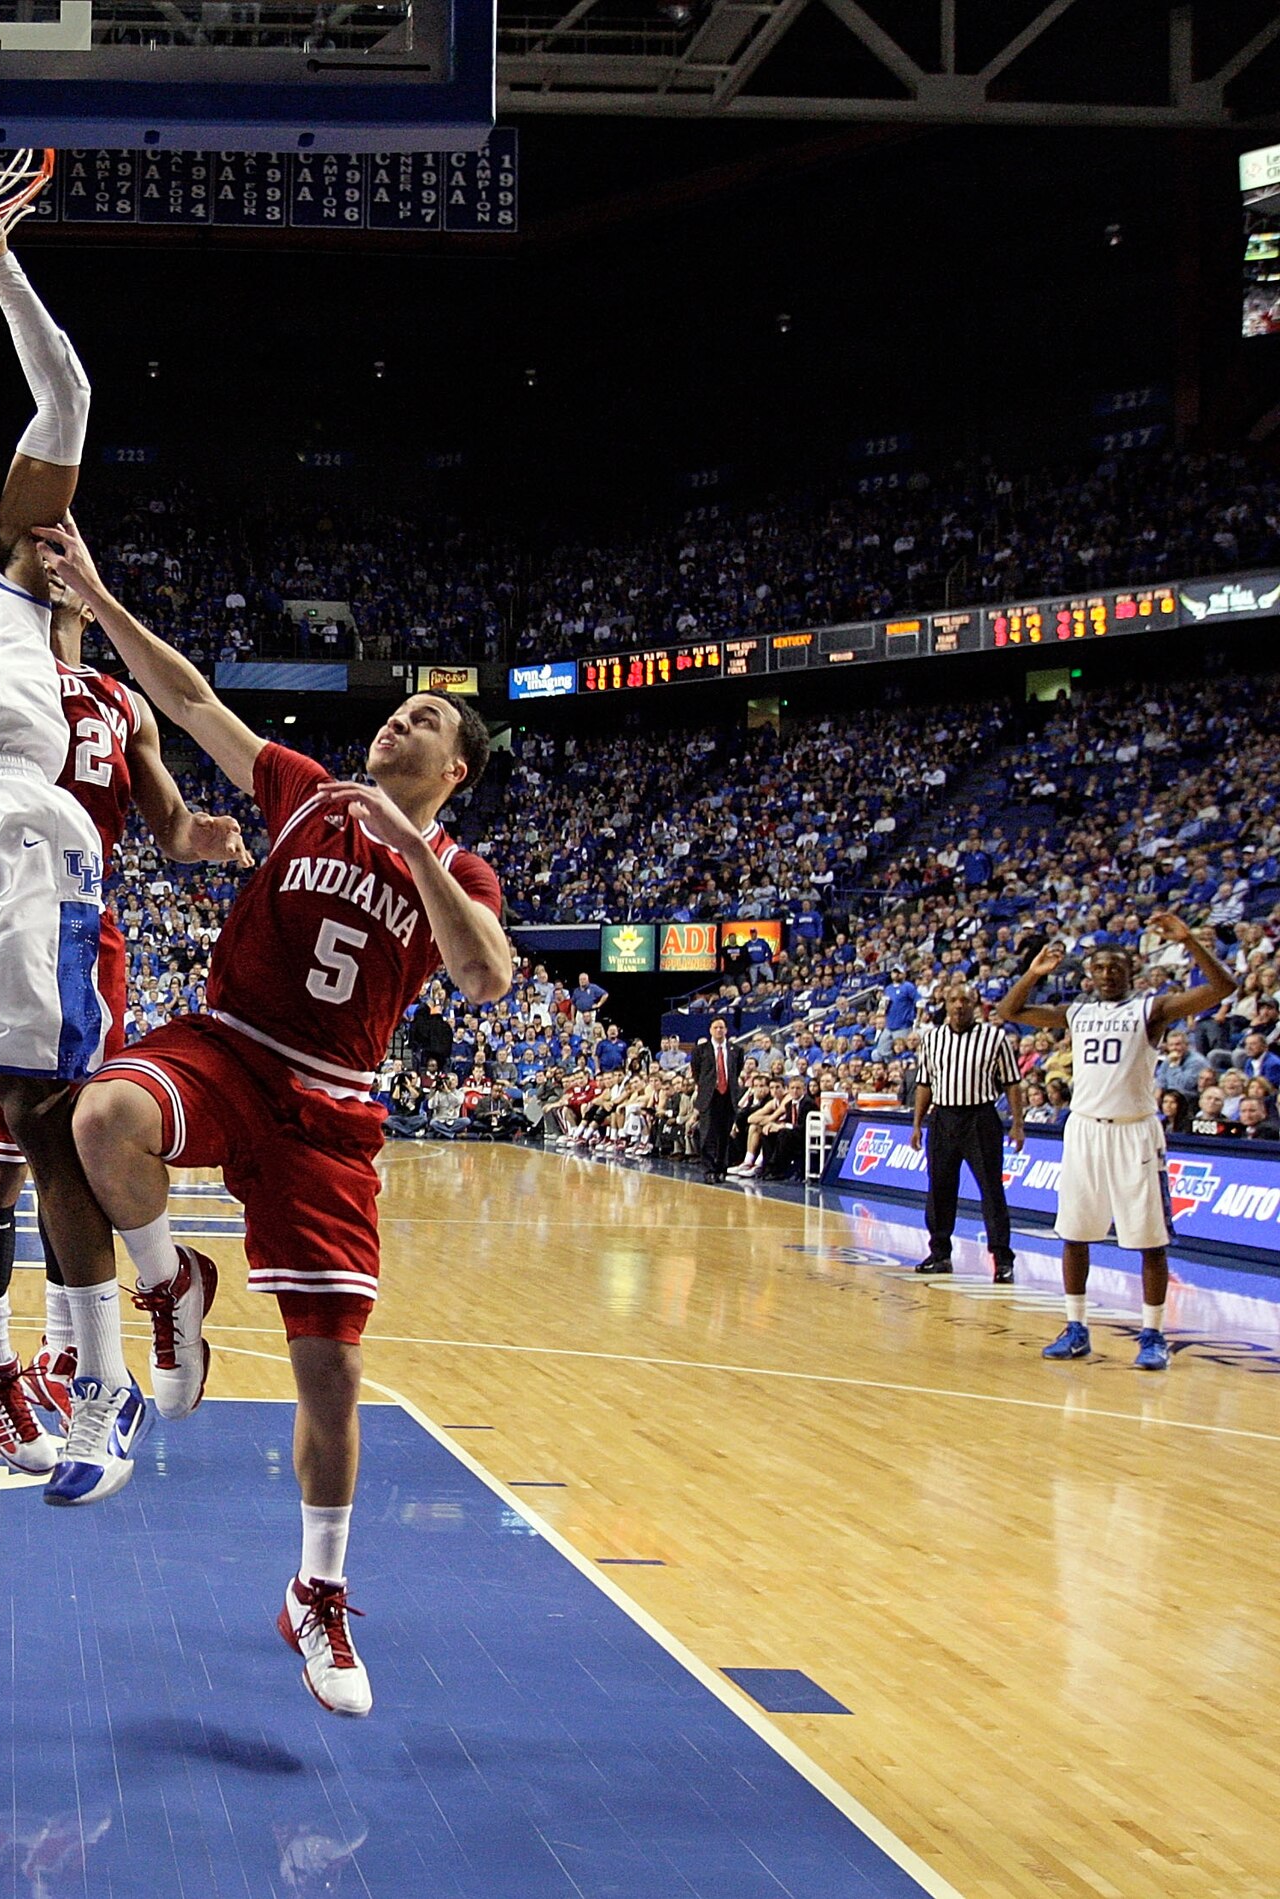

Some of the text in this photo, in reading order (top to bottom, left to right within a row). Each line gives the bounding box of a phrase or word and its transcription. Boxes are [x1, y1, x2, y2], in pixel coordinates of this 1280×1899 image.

[420, 153, 437, 223] 1997
[475, 141, 492, 223] HAMPION
[496, 154, 514, 225] 1998
[116, 449, 146, 463] 223
[773, 634, 812, 649] KENTUCKY
[514, 669, 538, 684] lynn
[526, 674, 572, 692] imaging
[74, 717, 113, 788] 2
[278, 856, 419, 948] INDIANA
[662, 924, 717, 956] ADI
[305, 918, 368, 1005] 5
[608, 956, 646, 965] WHITAKER
[1074, 1020, 1140, 1033] KENTUCKY
[1084, 1038, 1122, 1064] 20
[1192, 1120, 1218, 1134] POSS
[1211, 1183, 1280, 1222] AUTO
